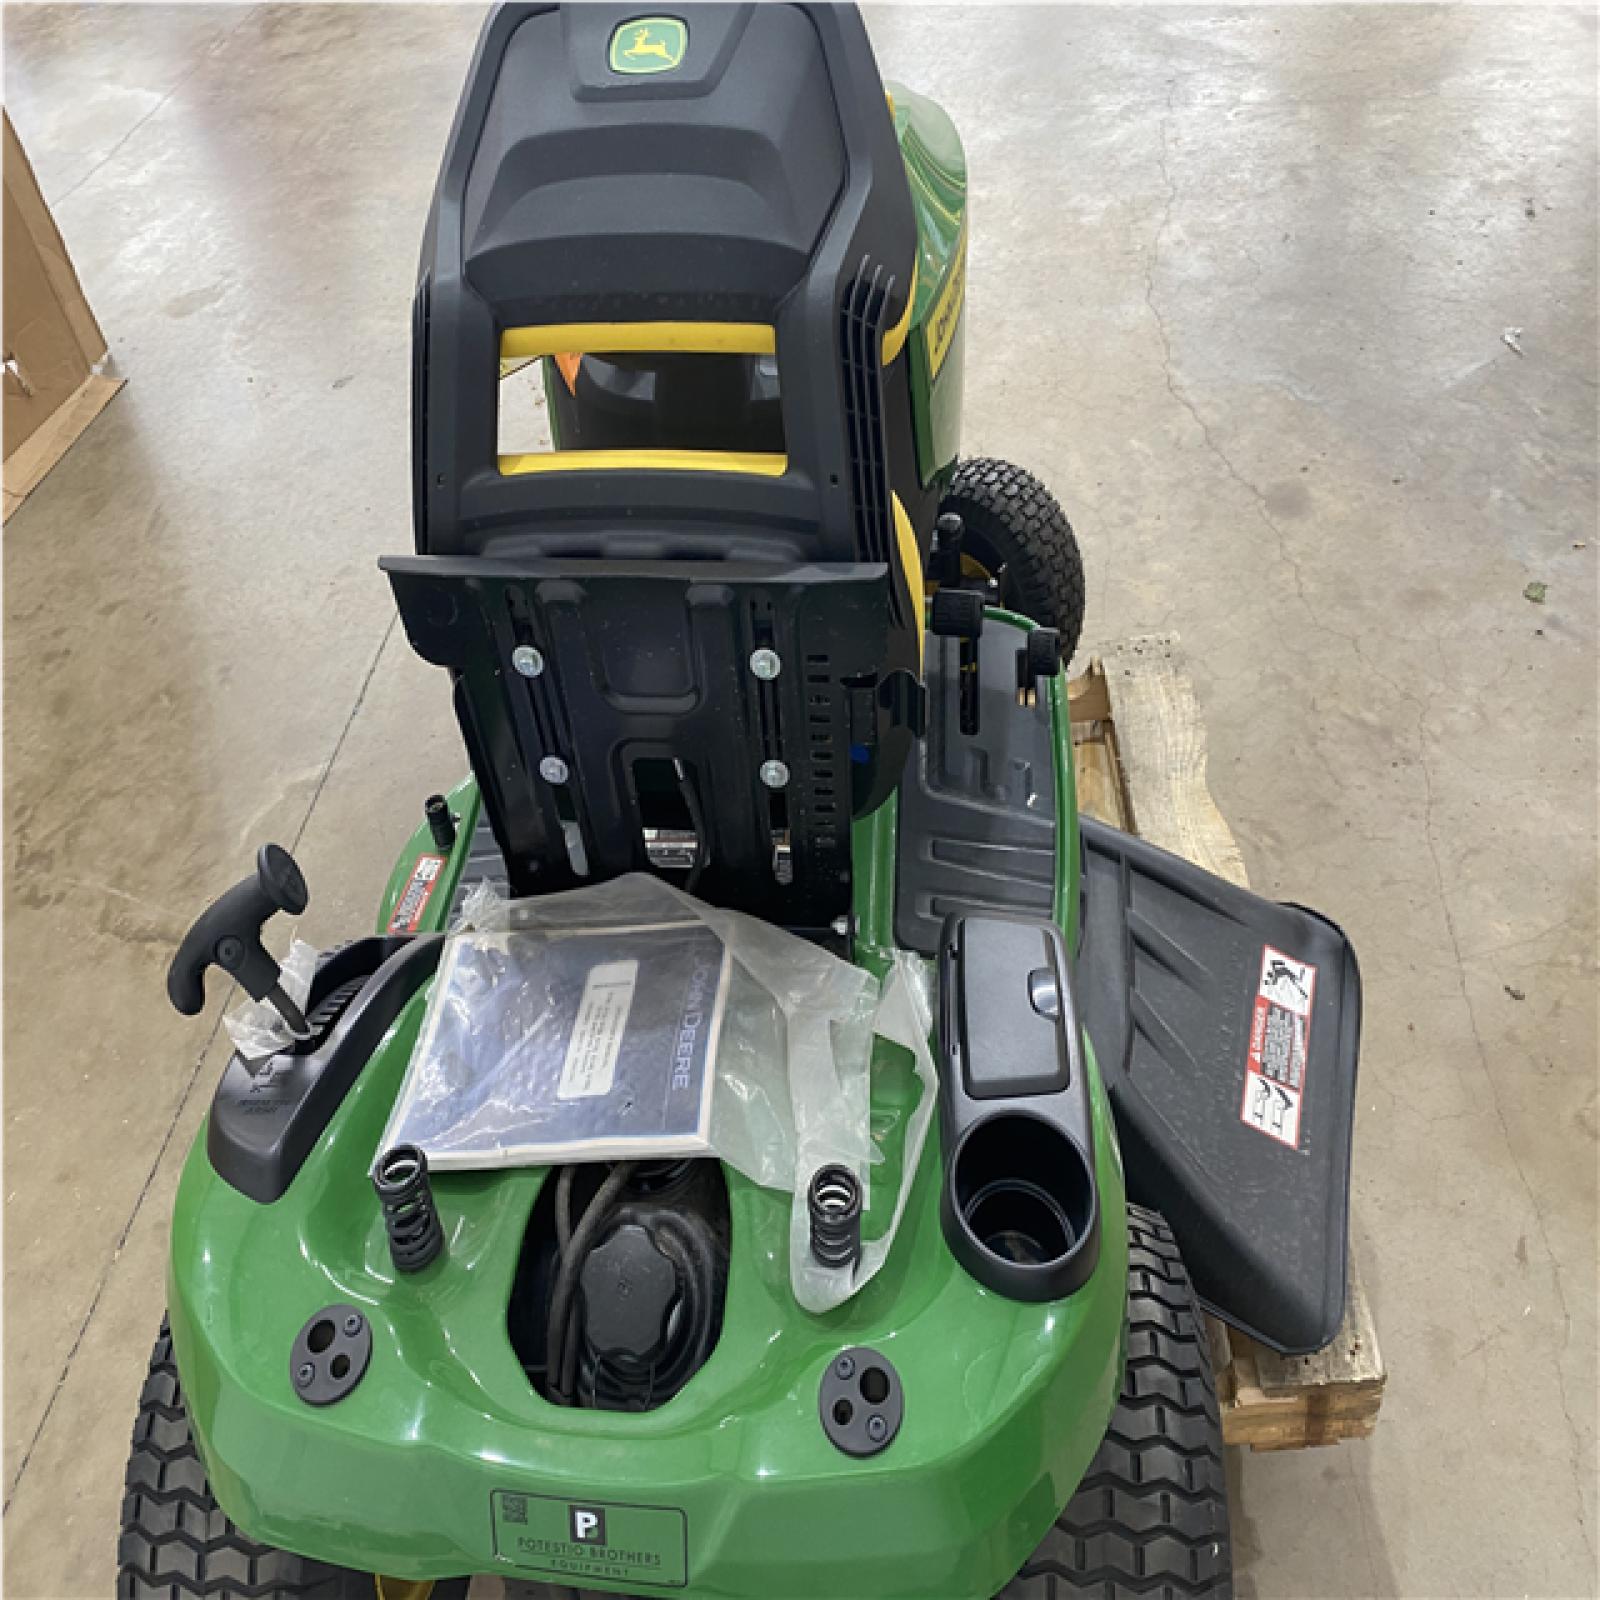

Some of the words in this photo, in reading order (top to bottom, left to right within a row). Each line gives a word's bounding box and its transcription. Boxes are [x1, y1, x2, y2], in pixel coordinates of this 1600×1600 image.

[518, 1537, 583, 1556] POTESTIO
[589, 1545, 662, 1567] BROTHERS
[551, 1560, 629, 1576] EQUIPMENT
